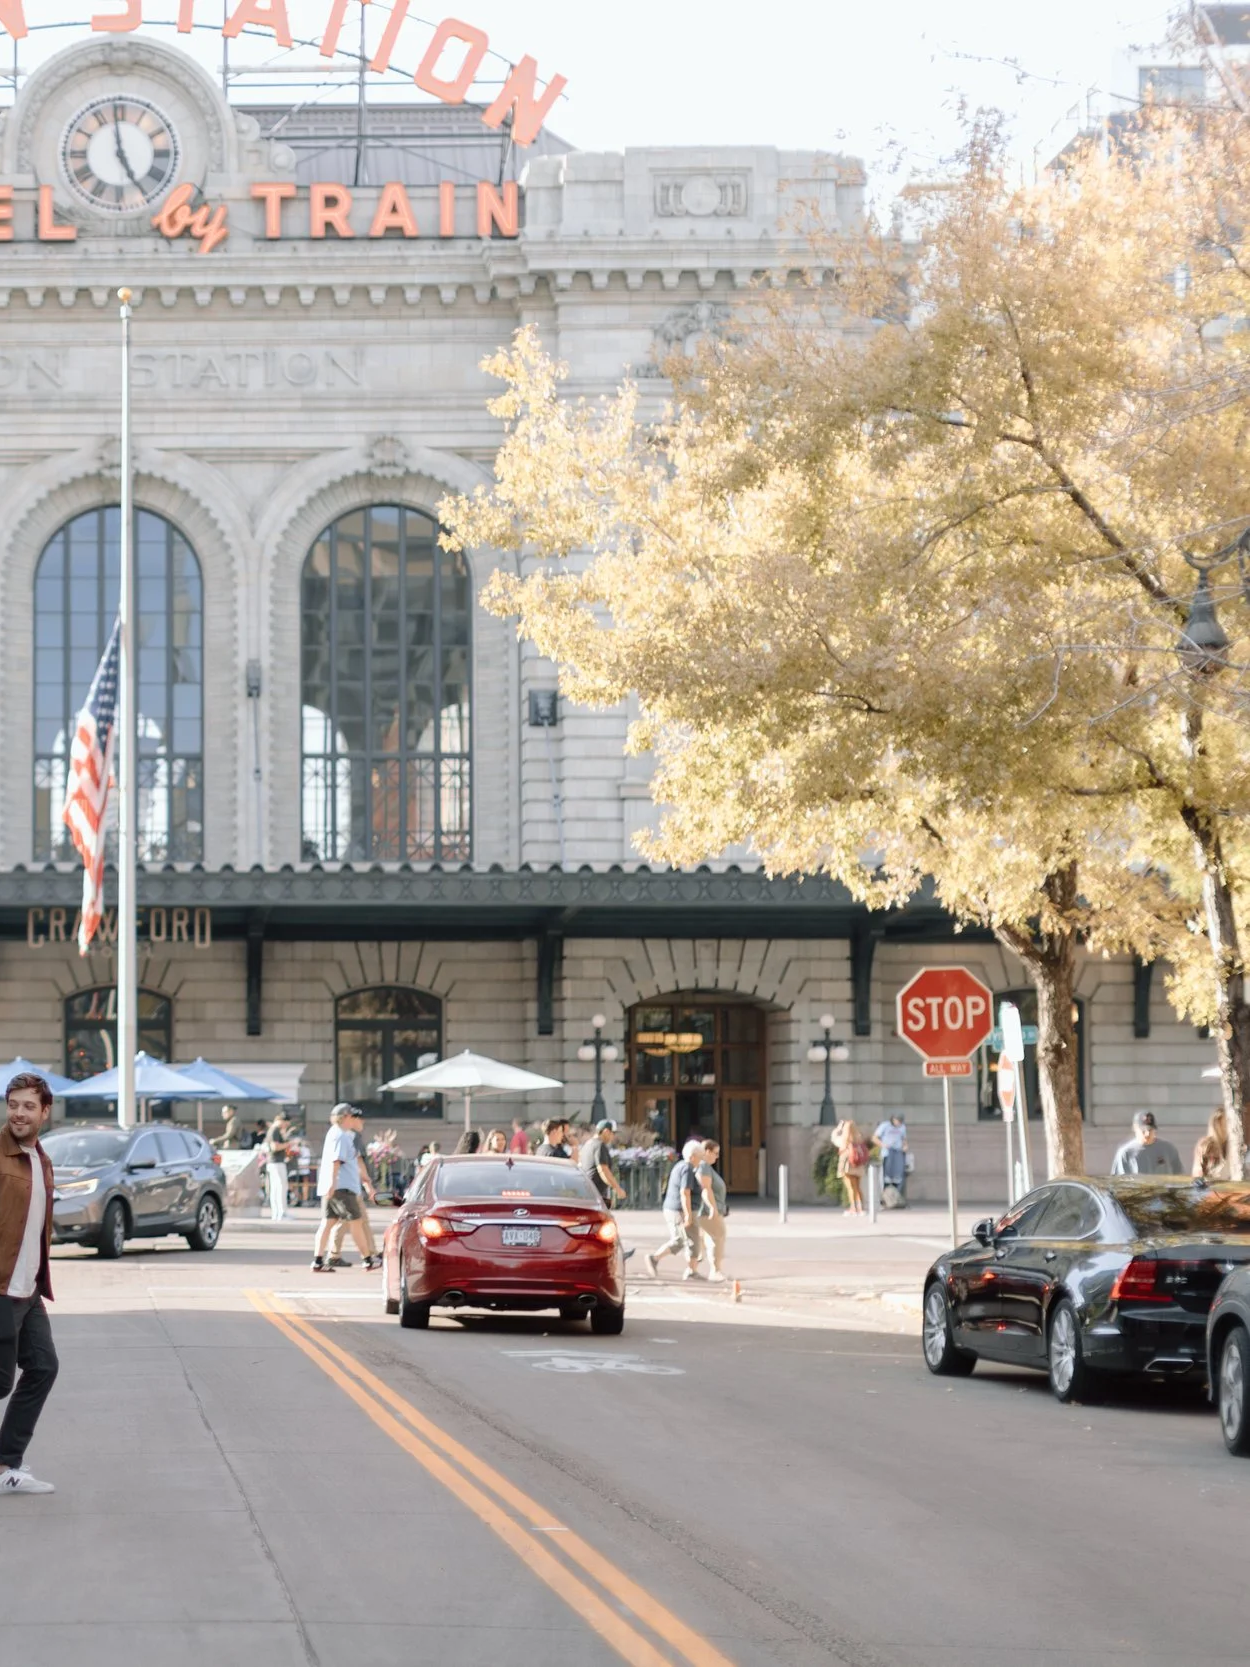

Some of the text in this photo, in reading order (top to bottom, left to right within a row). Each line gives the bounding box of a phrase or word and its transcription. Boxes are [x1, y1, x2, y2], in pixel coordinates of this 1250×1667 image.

[152, 182, 230, 254] by
[250, 180, 519, 240] TRAIN
[128, 349, 366, 389] STATION
[27, 907, 212, 949] CRWORD
[906, 995, 986, 1032] STOP
[929, 1062, 968, 1073] ALL WAY
